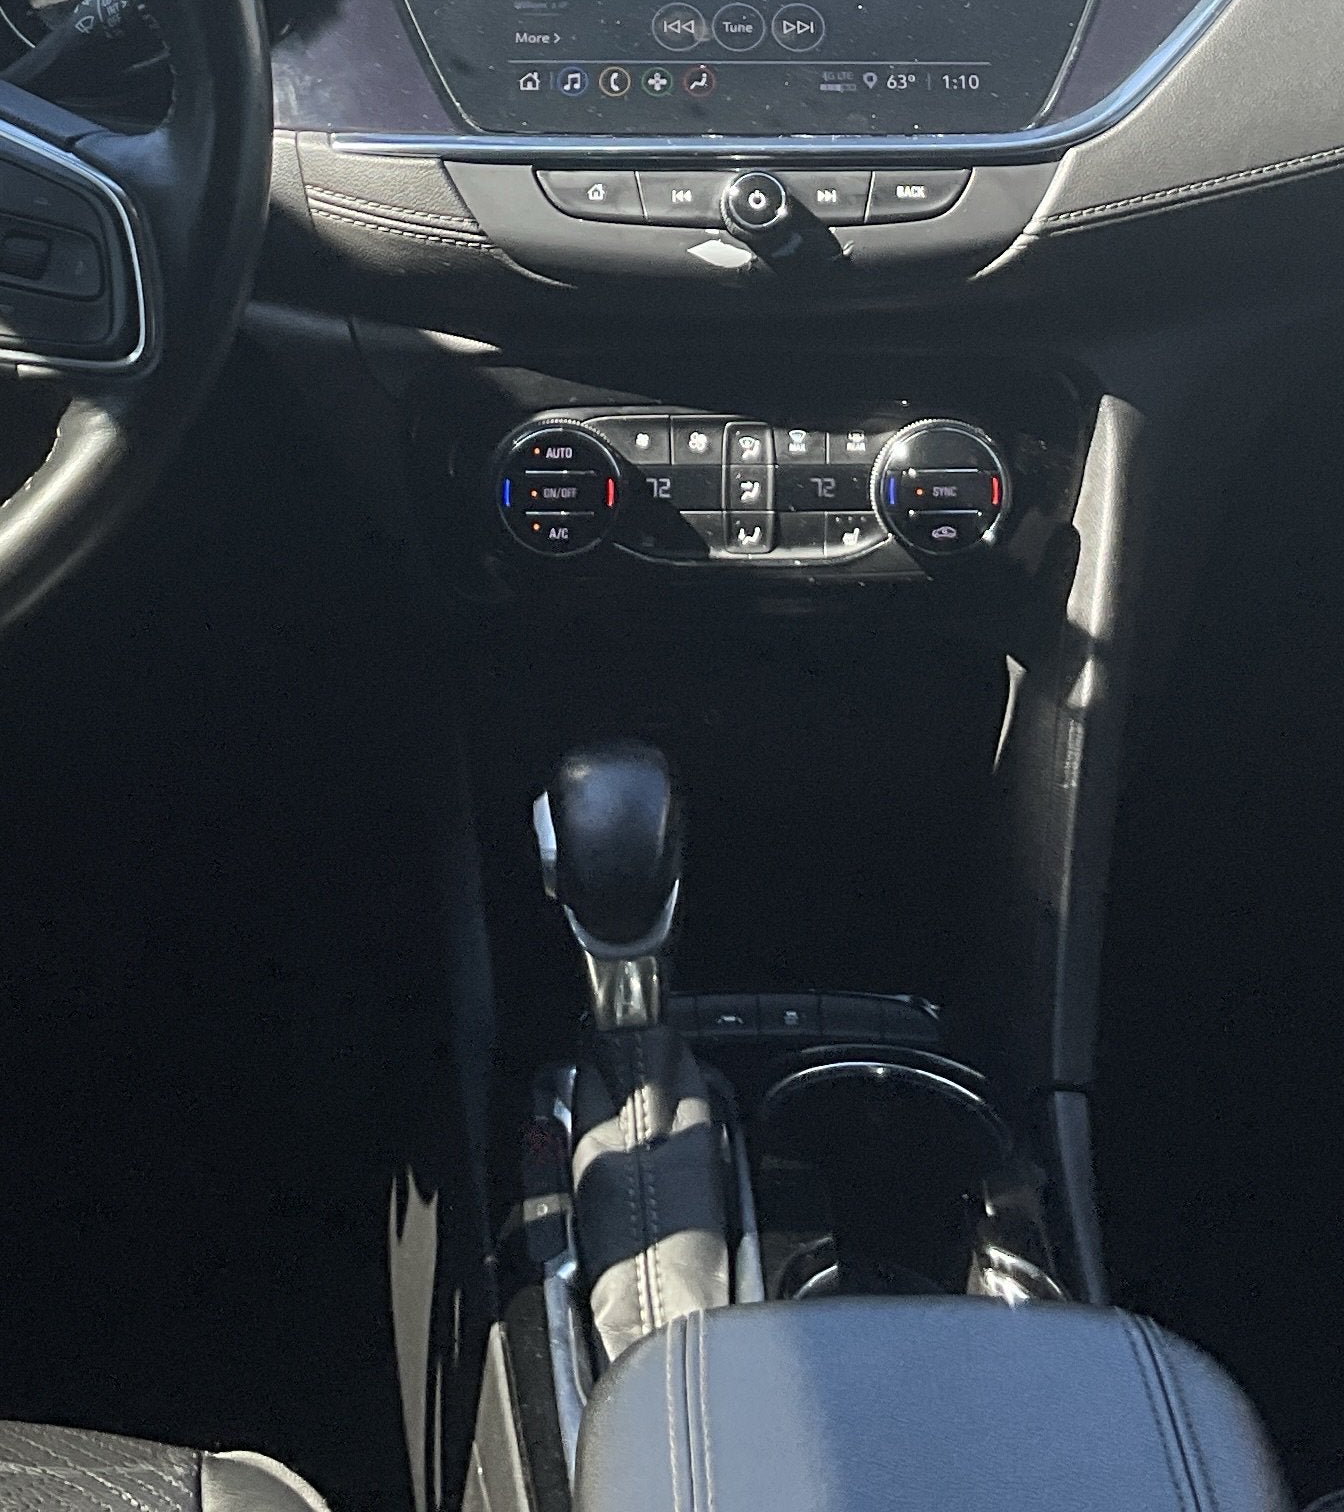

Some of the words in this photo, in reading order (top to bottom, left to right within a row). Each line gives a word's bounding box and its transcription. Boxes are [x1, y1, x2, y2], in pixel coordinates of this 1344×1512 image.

[722, 21, 753, 33] Tune
[515, 33, 550, 44] More
[942, 74, 980, 89] 1:10
[896, 185, 926, 198] BACK
[545, 447, 573, 459] AUTO
[543, 487, 577, 499] ON/OFF
[646, 477, 671, 498] 72
[809, 477, 836, 498] 72
[932, 486, 957, 497] SYNC
[548, 527, 569, 539] A/C
